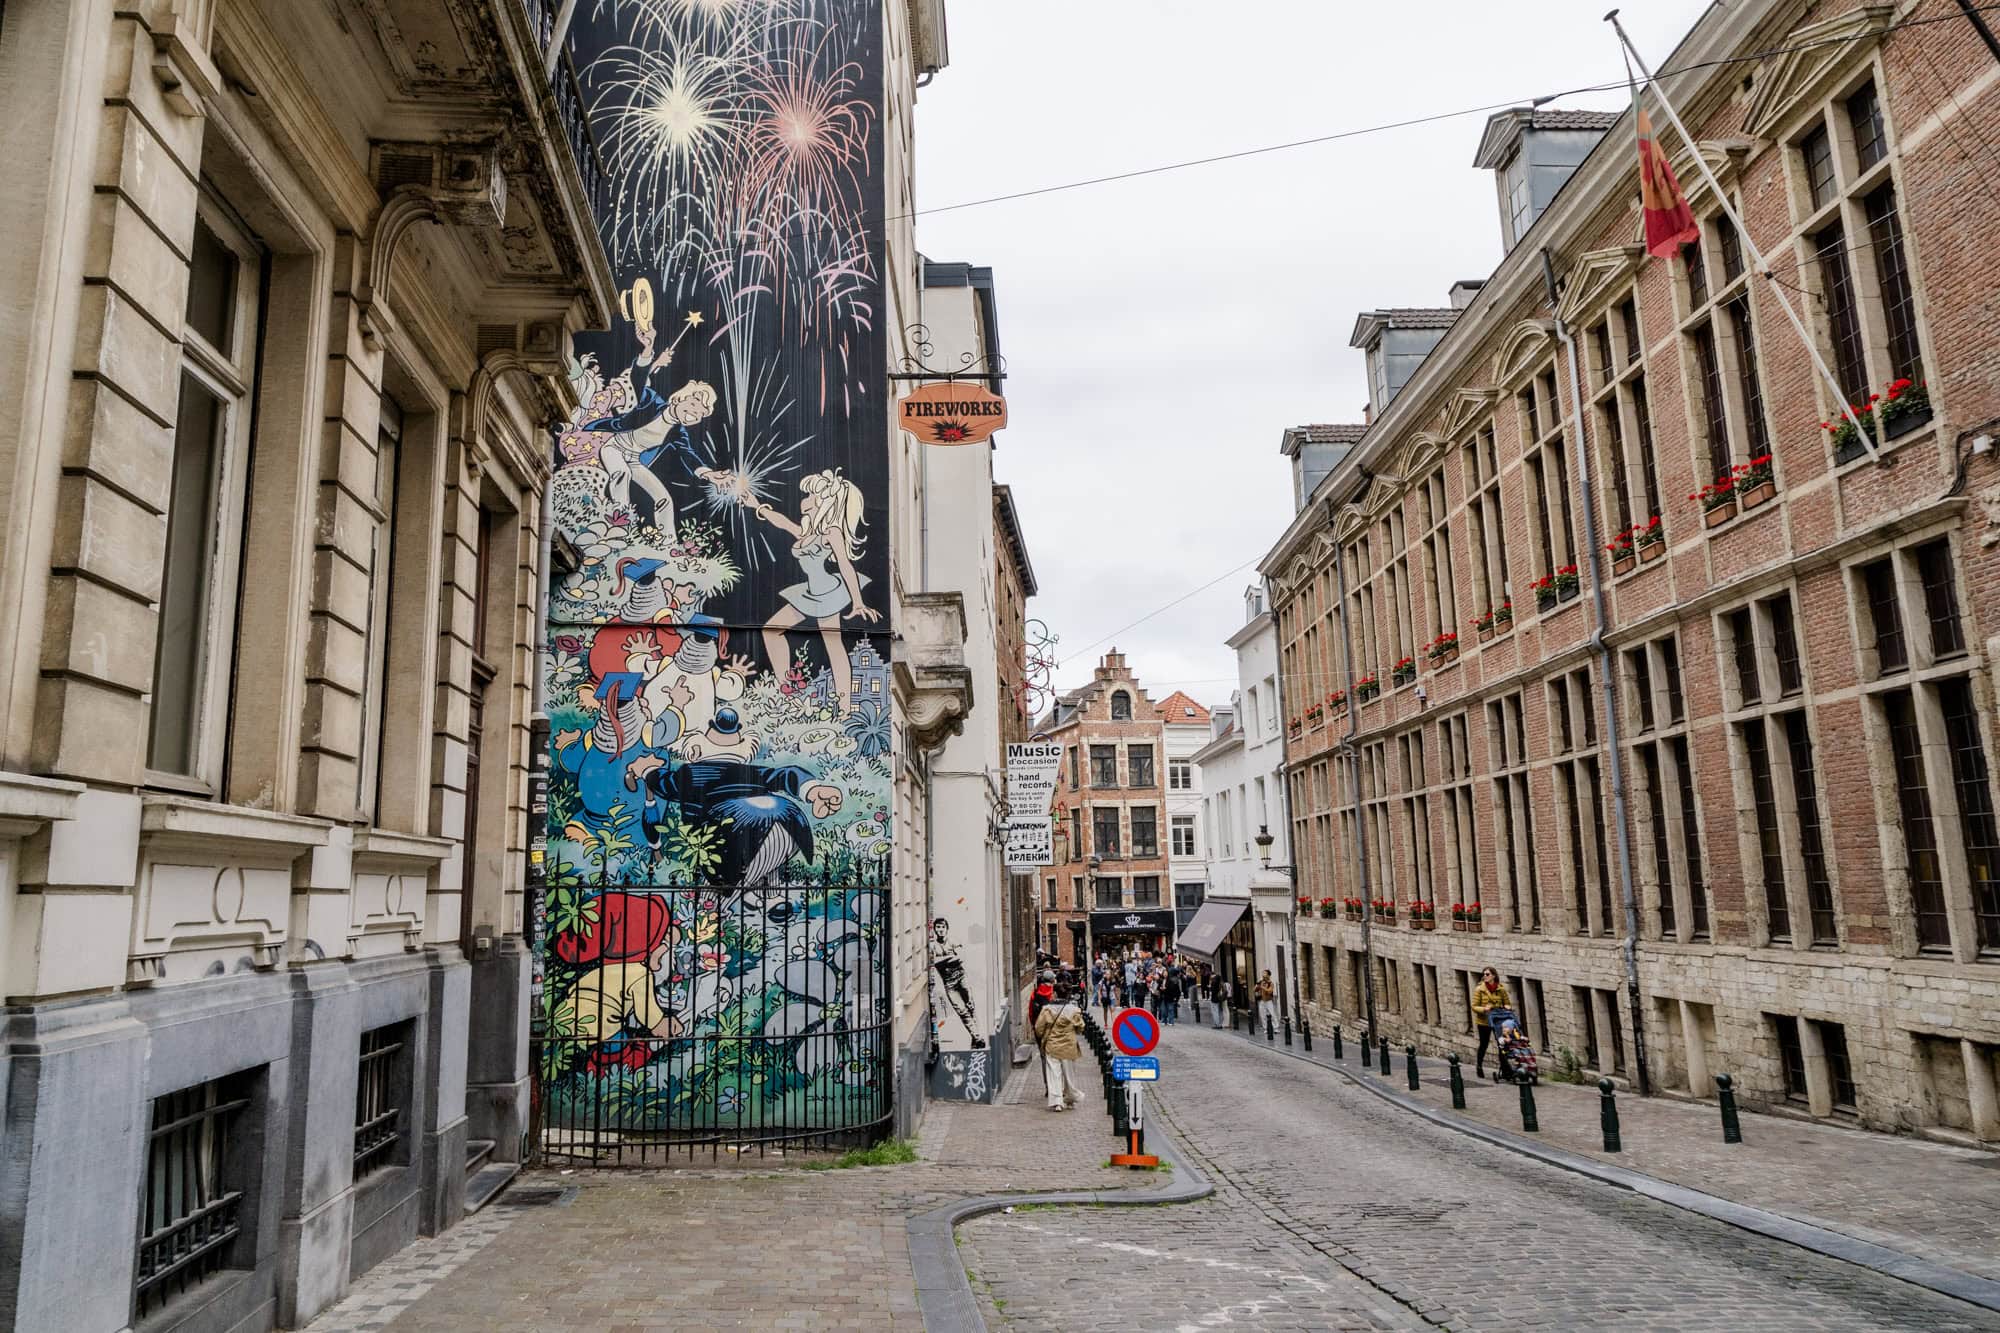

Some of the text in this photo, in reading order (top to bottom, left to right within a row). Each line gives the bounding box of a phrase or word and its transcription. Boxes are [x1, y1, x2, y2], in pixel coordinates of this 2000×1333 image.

[905, 401, 1002, 417] FIREWORKS
[1008, 744, 1061, 757] Music
[1008, 757, 1058, 766] d'occasion
[1018, 772, 1040, 781] hand
[1018, 781, 1053, 789] records
[1008, 853, 1050, 862] АРЛЕКИН
